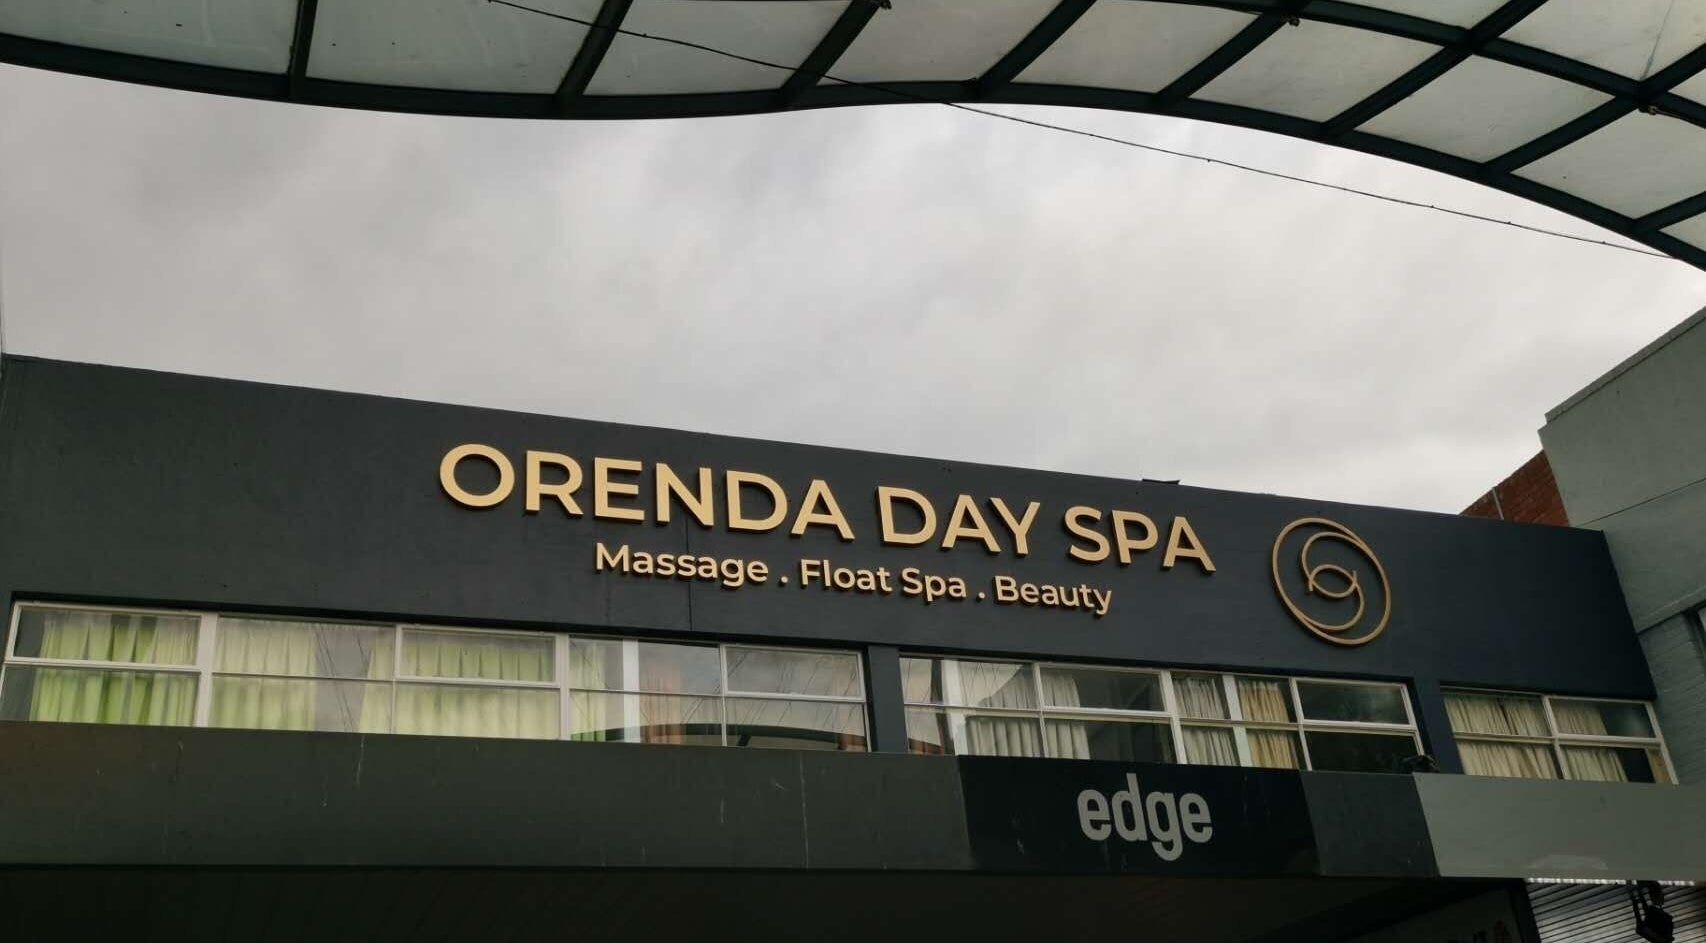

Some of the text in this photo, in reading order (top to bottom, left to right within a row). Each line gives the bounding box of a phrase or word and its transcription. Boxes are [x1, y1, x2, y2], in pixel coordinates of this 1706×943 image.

[439, 443, 1216, 572] ORENDA DAY SPA
[596, 542, 769, 588] Massage
[800, 558, 893, 592] Float
[901, 567, 967, 602] Spa
[995, 575, 1113, 616] Beauty
[1076, 772, 1214, 862] edge
